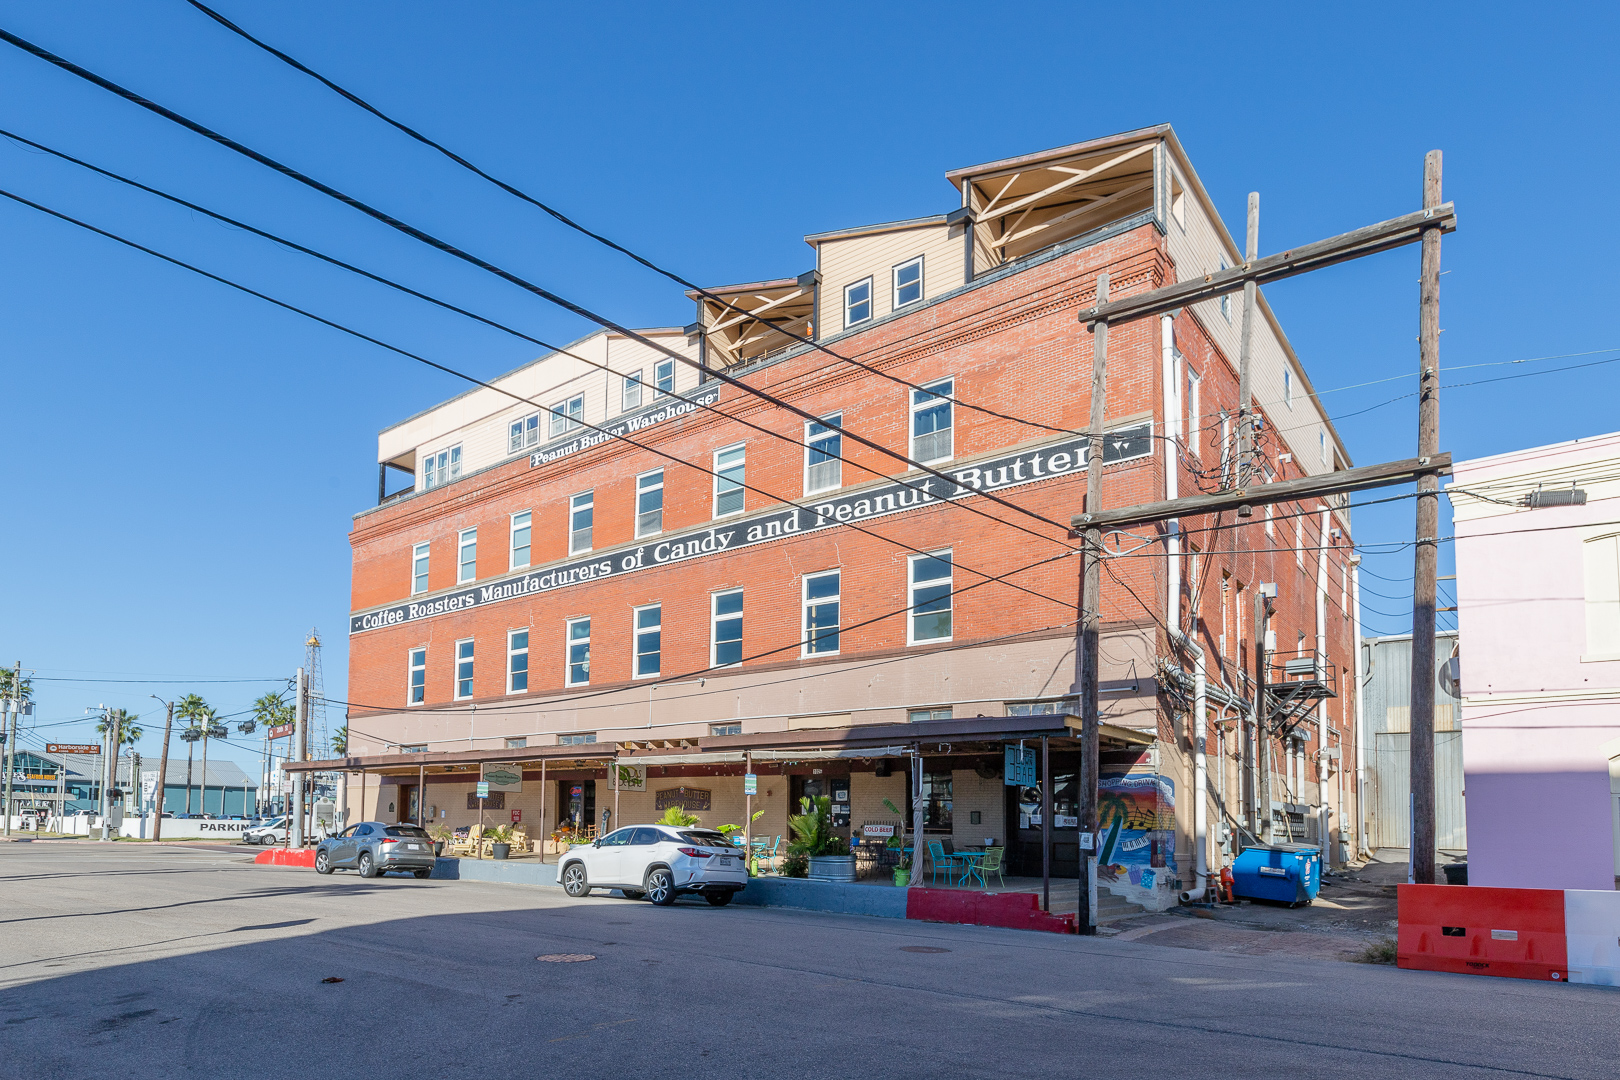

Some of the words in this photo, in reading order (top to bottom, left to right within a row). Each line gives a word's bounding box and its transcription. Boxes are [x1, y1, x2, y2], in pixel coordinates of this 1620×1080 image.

[408, 590, 475, 619] Roasters
[480, 560, 612, 603] Manufacturers
[621, 547, 644, 570] of
[654, 529, 735, 562] Candy
[746, 509, 801, 541] and
[814, 480, 936, 527] Peanut
[953, 446, 1089, 495] Butter
[1016, 765, 1033, 783] BAR
[656, 790, 679, 800] PEANUT
[684, 790, 709, 800] BUTTER
